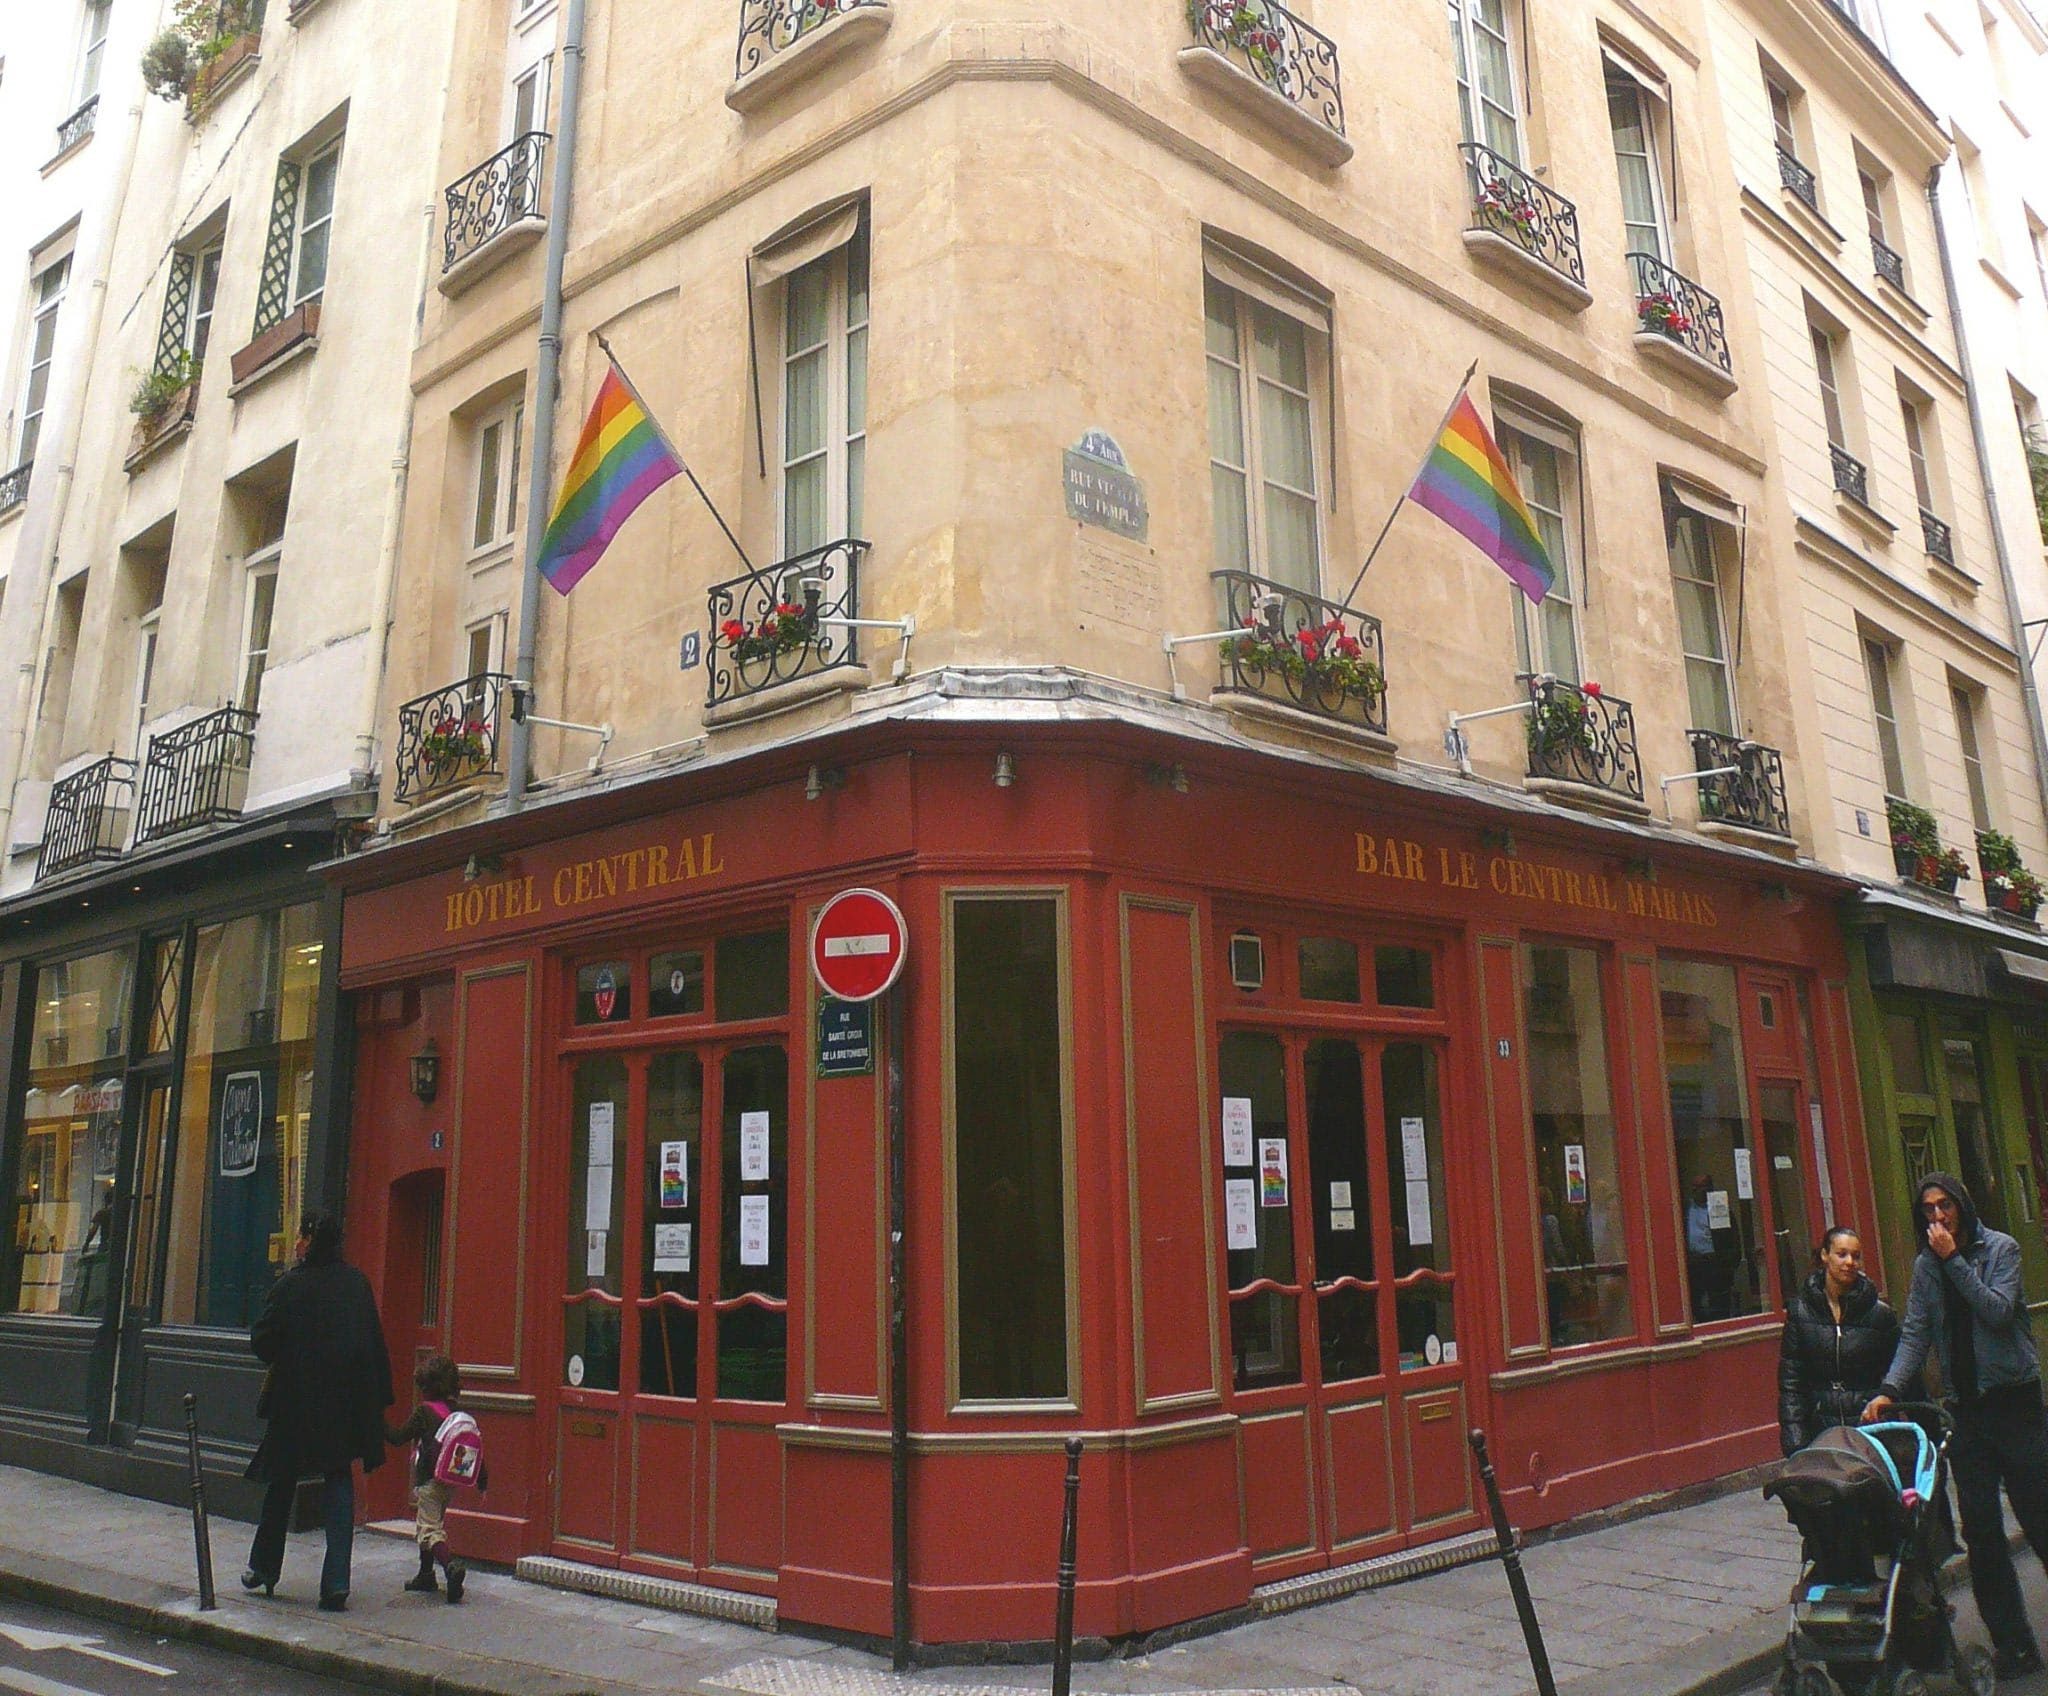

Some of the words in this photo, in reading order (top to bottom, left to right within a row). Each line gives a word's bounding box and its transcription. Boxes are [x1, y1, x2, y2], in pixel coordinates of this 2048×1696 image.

[1075, 490, 1089, 510] DU
[686, 637, 695, 664] 2
[444, 875, 542, 932] HÔTEL
[552, 832, 725, 907] CENTRAL
[1354, 832, 1427, 883] BAR
[1437, 847, 1479, 890] LE
[1489, 857, 1618, 913] CENTRAL
[1626, 880, 1718, 928] MARAIS
[840, 1012, 850, 1022] RUE
[830, 1051, 836, 1060] LA
